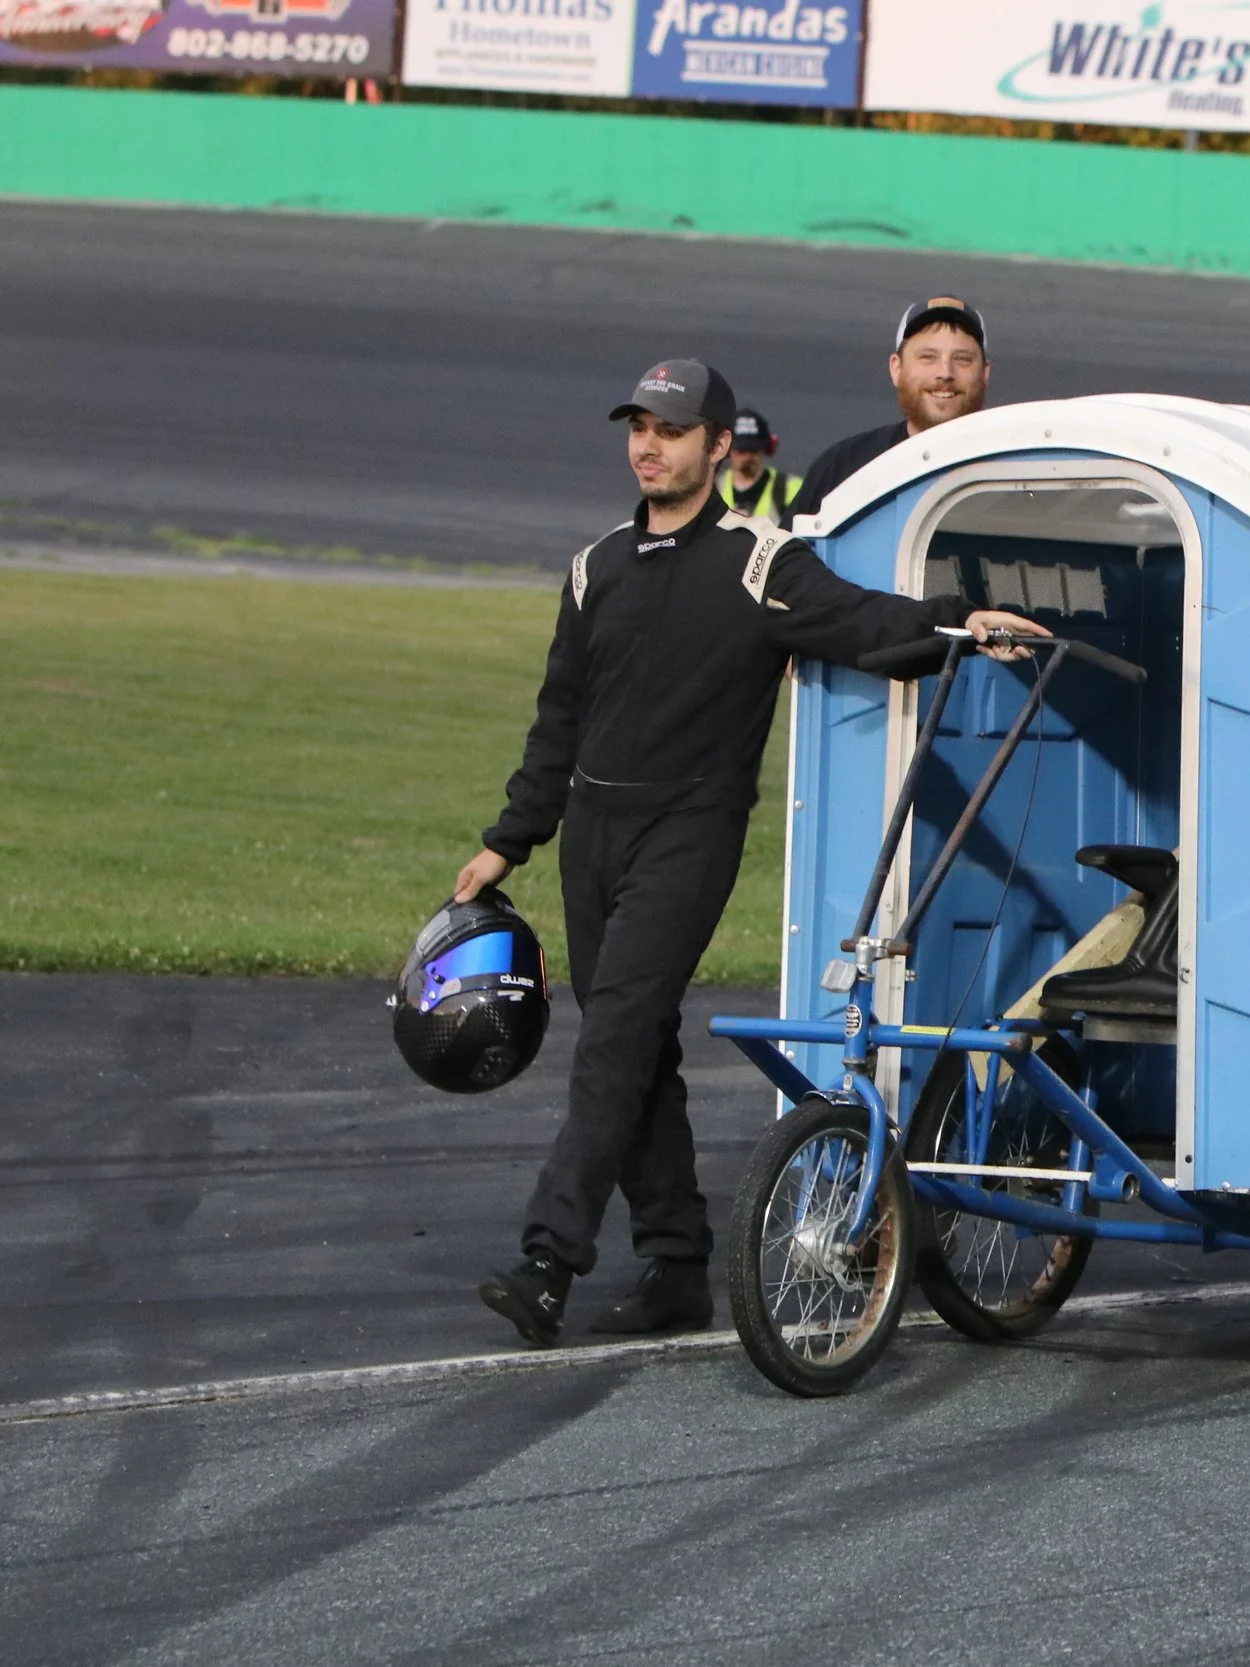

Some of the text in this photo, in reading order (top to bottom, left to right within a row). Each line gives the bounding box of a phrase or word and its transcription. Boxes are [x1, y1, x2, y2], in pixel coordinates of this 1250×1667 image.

[648, 0, 848, 56] Arandas
[638, 538, 676, 554] sparco
[749, 538, 777, 586] sparco
